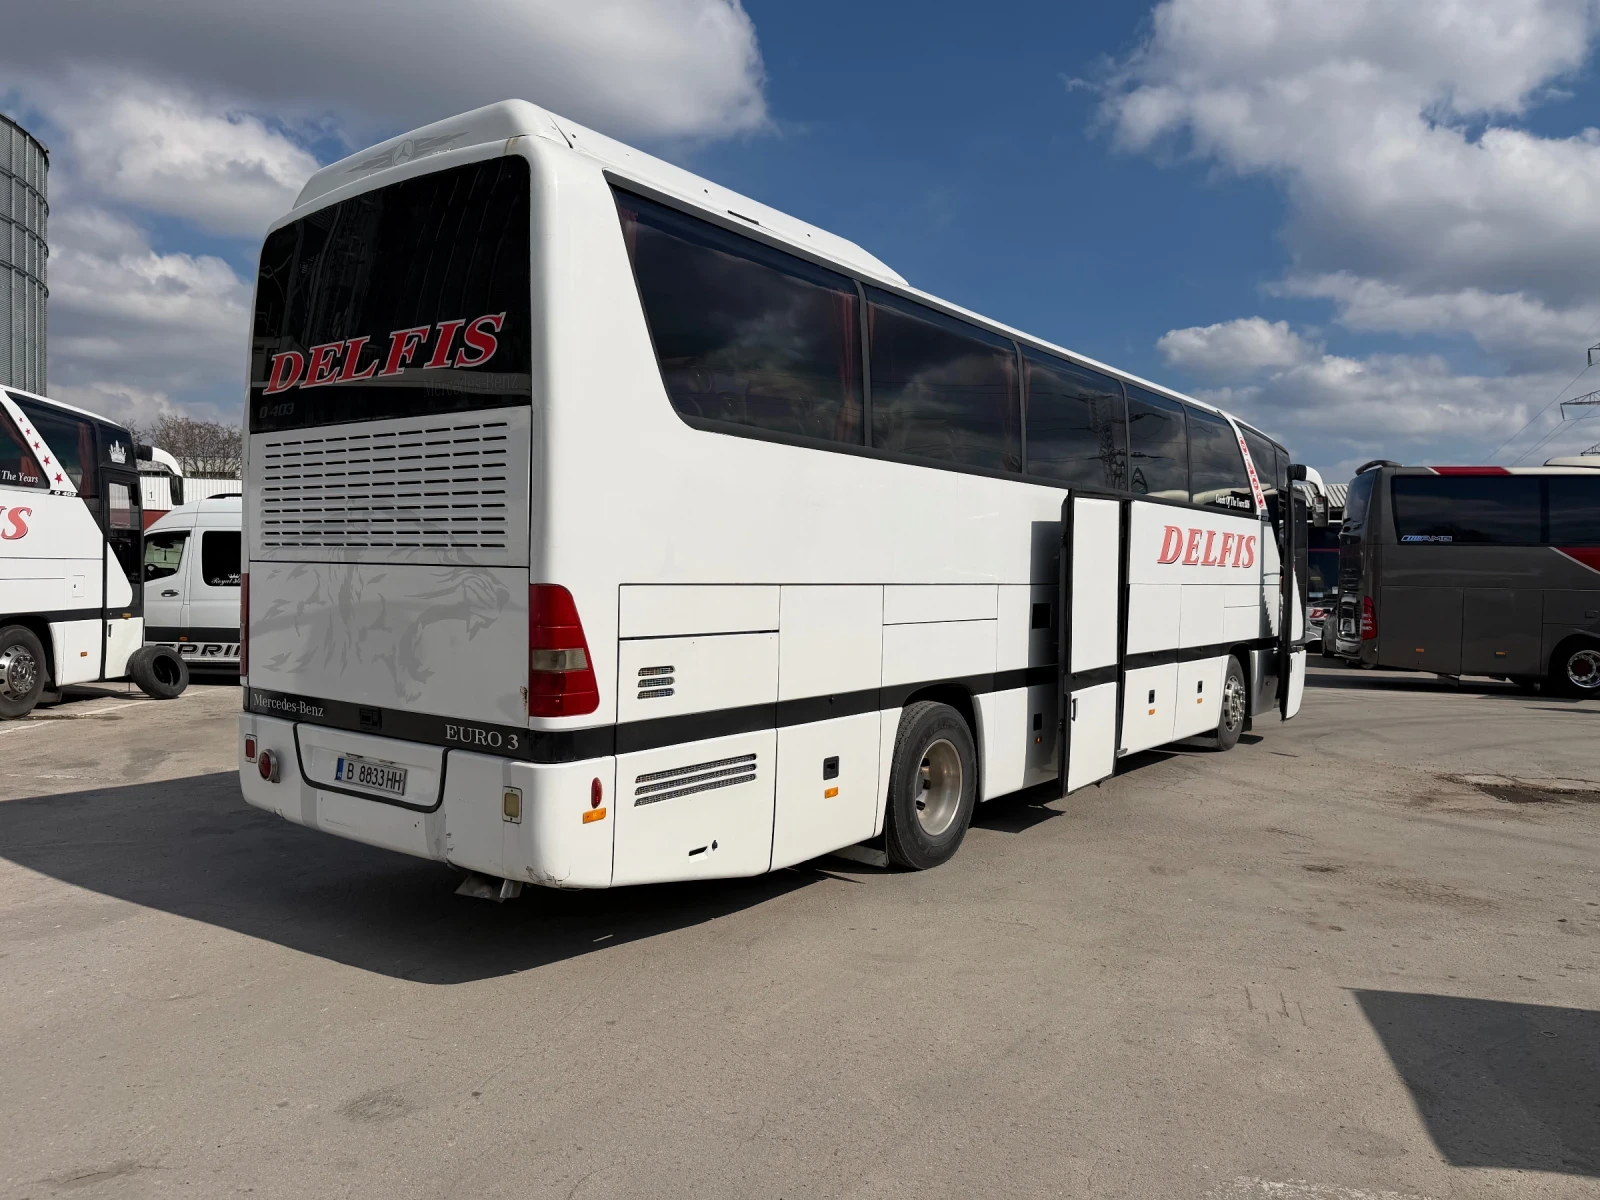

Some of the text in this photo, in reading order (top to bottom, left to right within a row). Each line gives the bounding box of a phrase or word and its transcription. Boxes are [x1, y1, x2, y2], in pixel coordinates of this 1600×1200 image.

[262, 311, 507, 395] DELFIS
[424, 372, 519, 398] Mercedes-Benz
[269, 402, 295, 417] 403
[1, 470, 39, 484] The Years
[1157, 525, 1257, 569] DELFIS
[156, 643, 240, 658] PRI
[253, 693, 325, 717] Mercedes-Benz
[445, 724, 519, 750] EURO 3
[346, 762, 355, 780] B
